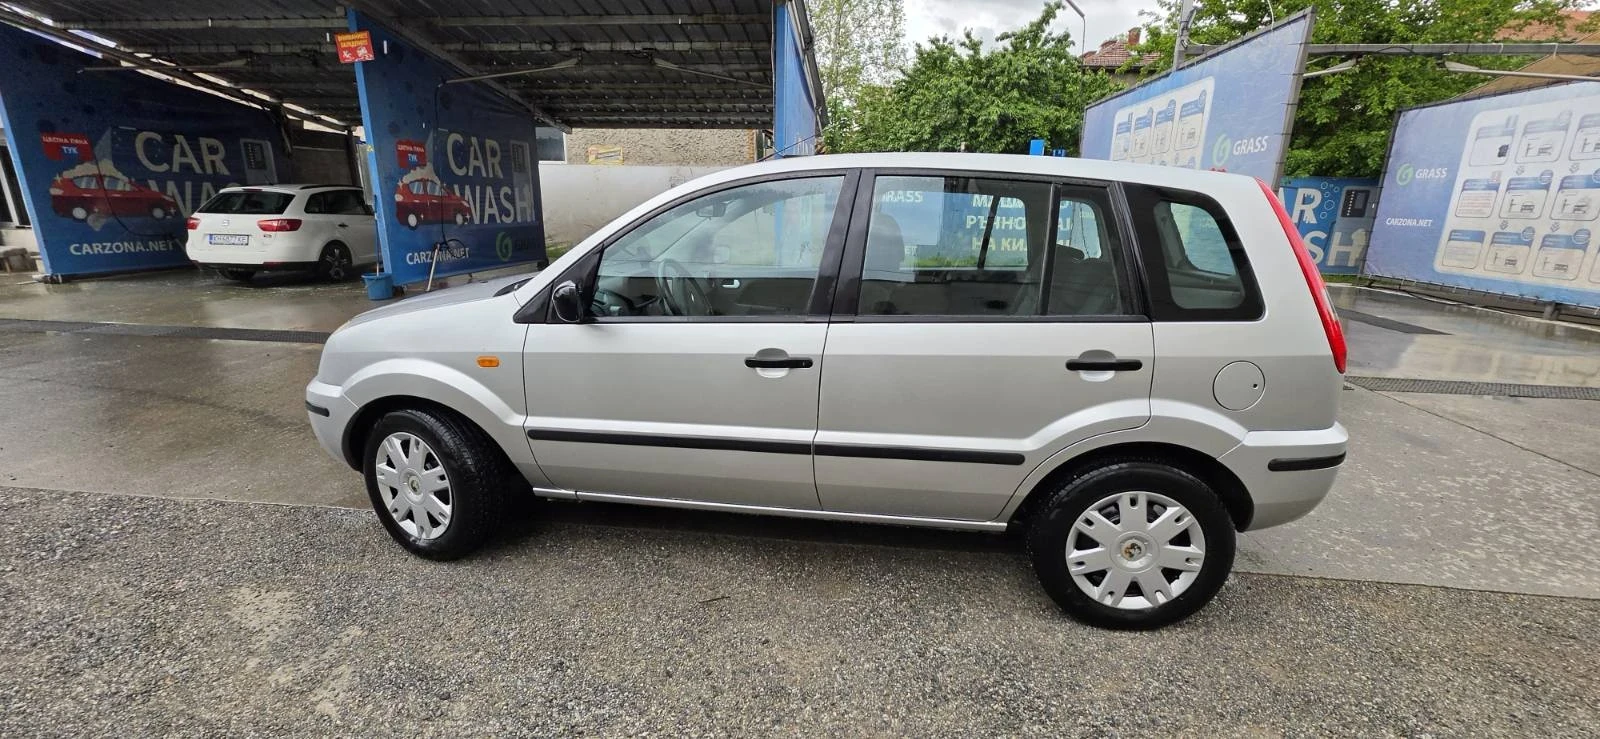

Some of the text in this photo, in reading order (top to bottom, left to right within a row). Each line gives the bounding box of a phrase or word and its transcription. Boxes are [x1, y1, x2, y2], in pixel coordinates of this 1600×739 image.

[135, 131, 230, 176] CAR
[1232, 135, 1270, 156] GRASS
[447, 132, 504, 179] CAR
[1415, 167, 1448, 179] GRASS
[1385, 217, 1433, 227] CARZONA.NET
[69, 239, 175, 255] CARZONA.NET
